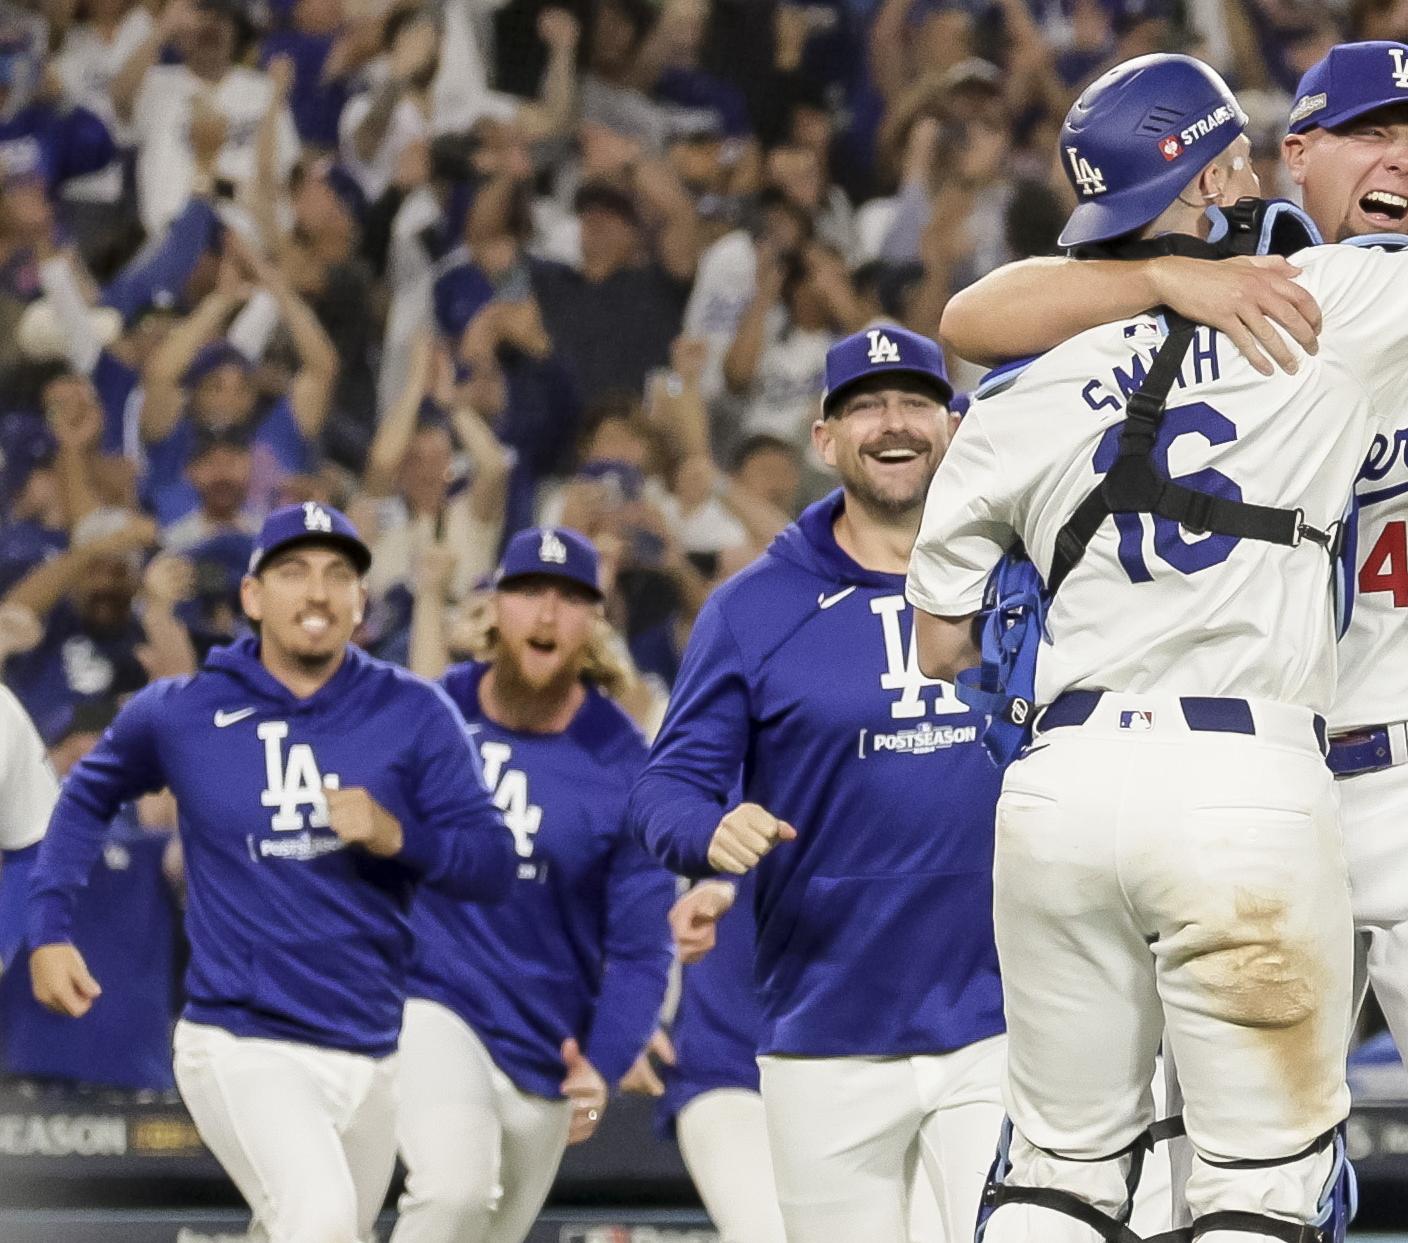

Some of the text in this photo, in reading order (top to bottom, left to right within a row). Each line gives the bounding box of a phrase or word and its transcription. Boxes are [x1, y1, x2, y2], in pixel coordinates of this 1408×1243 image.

[1065, 146, 1107, 196] LA
[866, 329, 901, 363] LA
[1082, 325, 1220, 412] SMH
[302, 501, 332, 533] LA
[539, 530, 568, 564] LA
[873, 726, 977, 752] POSTSEASON
[256, 720, 340, 832] LA
